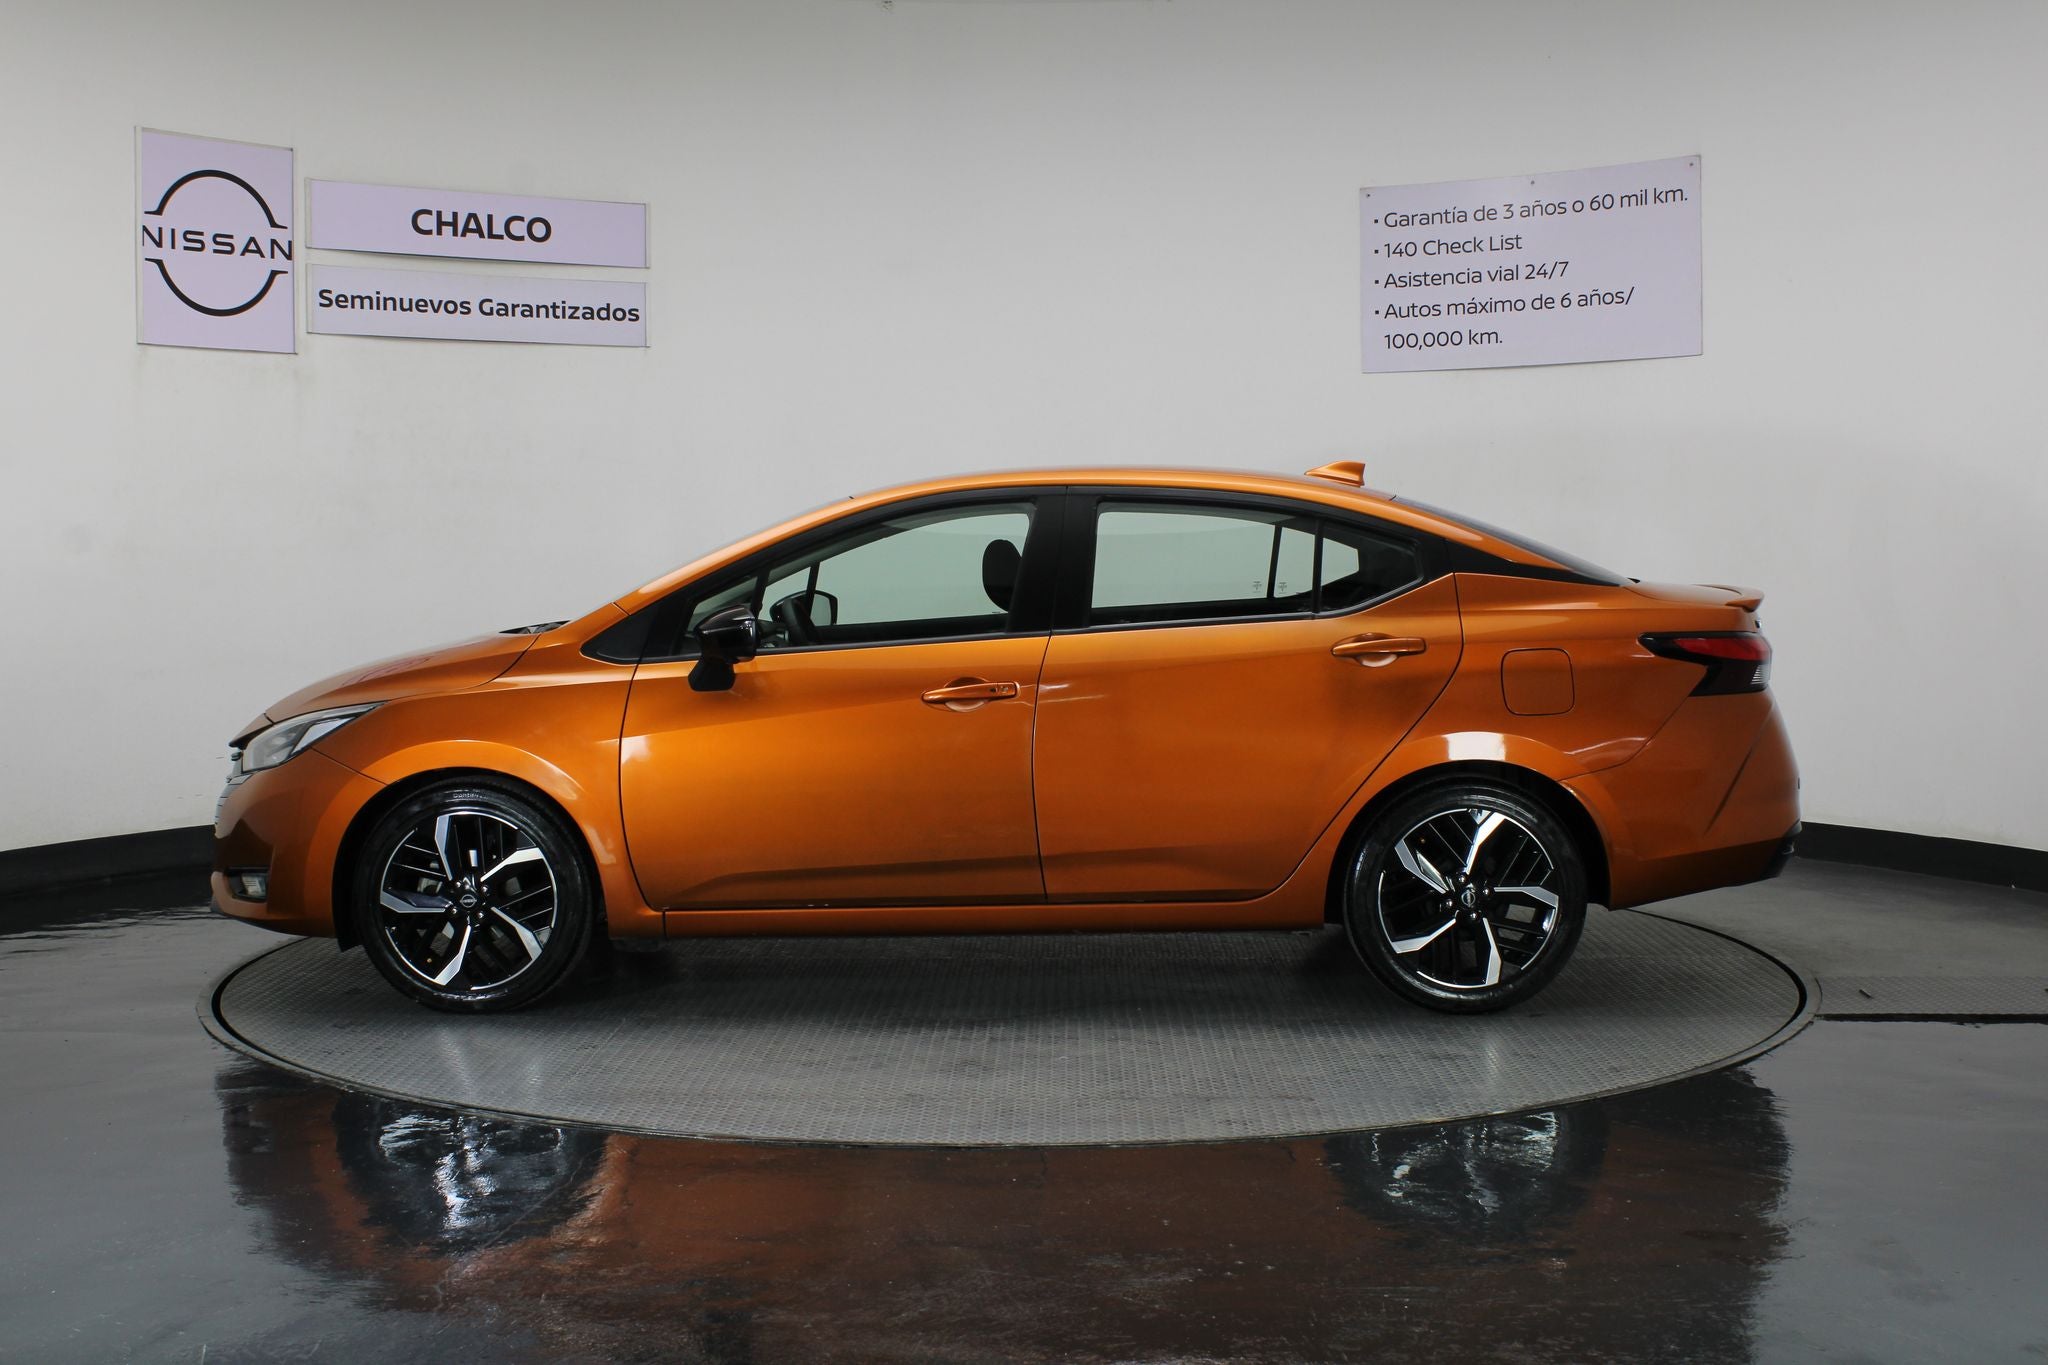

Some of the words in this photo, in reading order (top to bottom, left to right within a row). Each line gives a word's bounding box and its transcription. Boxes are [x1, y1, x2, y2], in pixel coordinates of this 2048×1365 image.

[1383, 206, 1468, 228] Garantía
[1473, 203, 1498, 222] de
[1503, 203, 1514, 221] 3
[1519, 198, 1567, 219] años
[1571, 199, 1585, 213] o
[1589, 193, 1615, 213] 60
[1620, 188, 1648, 209] mil
[1653, 187, 1688, 205] km.
[142, 224, 293, 261] NISSAN
[411, 208, 552, 243] CHALCO
[1383, 240, 1418, 259] 140
[1422, 236, 1484, 257] Check
[1489, 233, 1524, 252] List
[1383, 269, 1483, 289] Asistencia
[1486, 264, 1519, 283] vial
[1524, 260, 1570, 282] 24/7
[318, 288, 473, 317] Seminuevos
[478, 292, 641, 323] Garantizados
[1383, 301, 1442, 320] Autos
[1447, 296, 1526, 316] máximo
[1530, 293, 1556, 311] de
[1560, 292, 1572, 309] 6
[1577, 286, 1635, 308] años/
[1384, 330, 1463, 351] 100,000
[1468, 328, 1503, 346] km.
